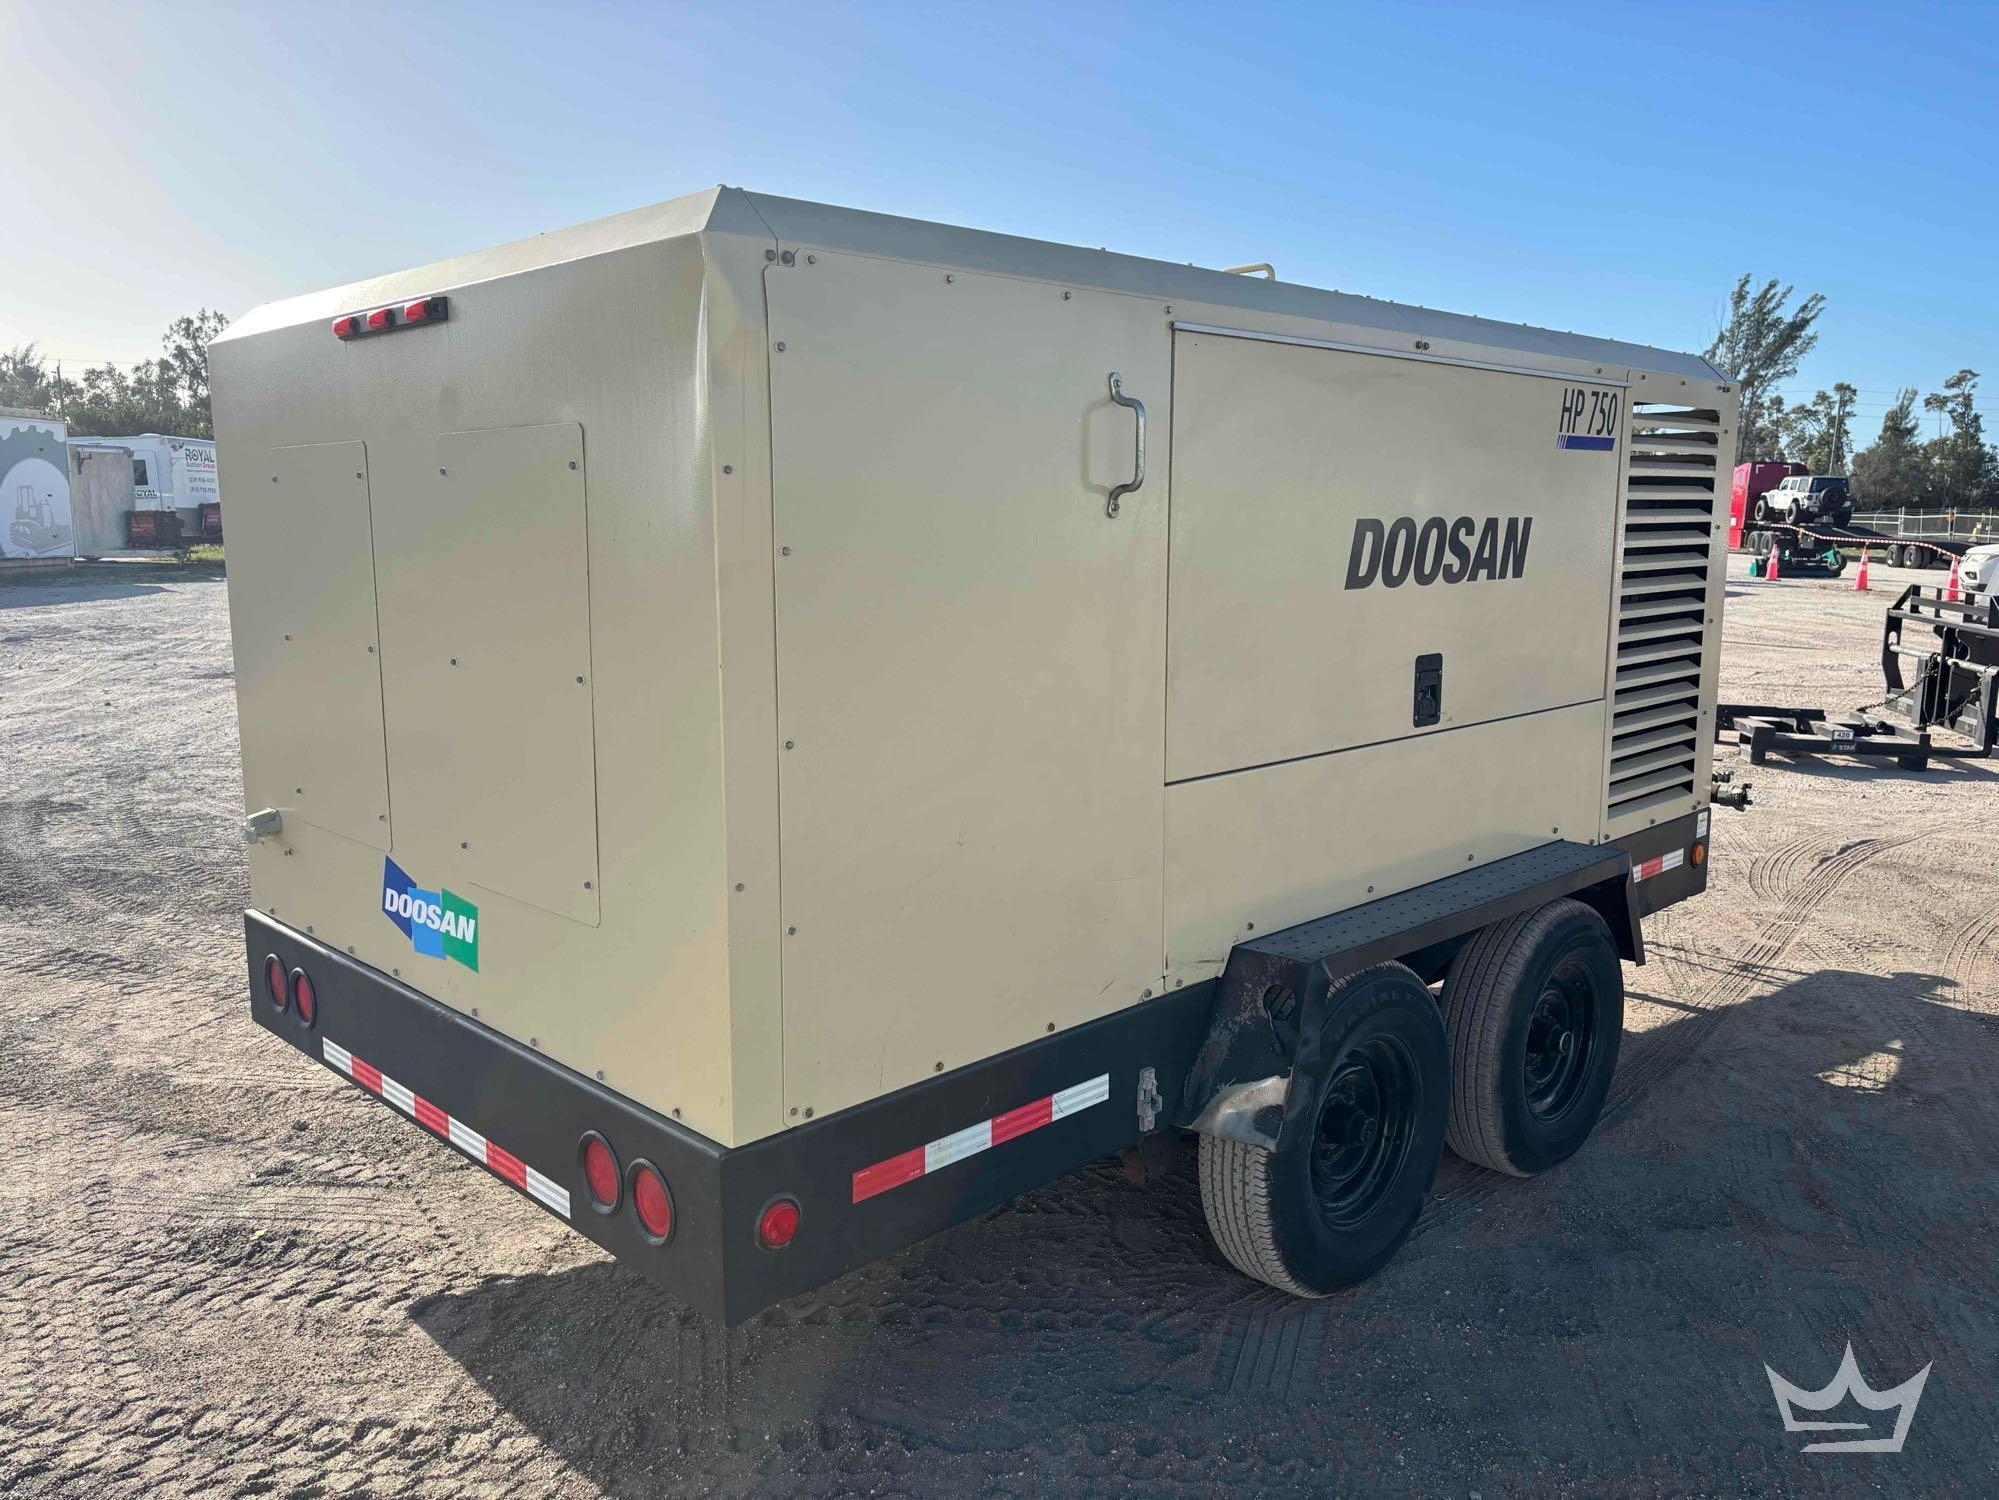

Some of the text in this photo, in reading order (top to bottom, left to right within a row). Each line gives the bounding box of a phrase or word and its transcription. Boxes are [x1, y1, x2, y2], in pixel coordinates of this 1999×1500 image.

[1559, 388, 1618, 436] HP 750
[185, 449, 215, 463] ROYAL
[136, 489, 157, 497] OYAL
[1344, 516, 1533, 590] DOOSAN
[385, 888, 476, 944] DOOSAN
